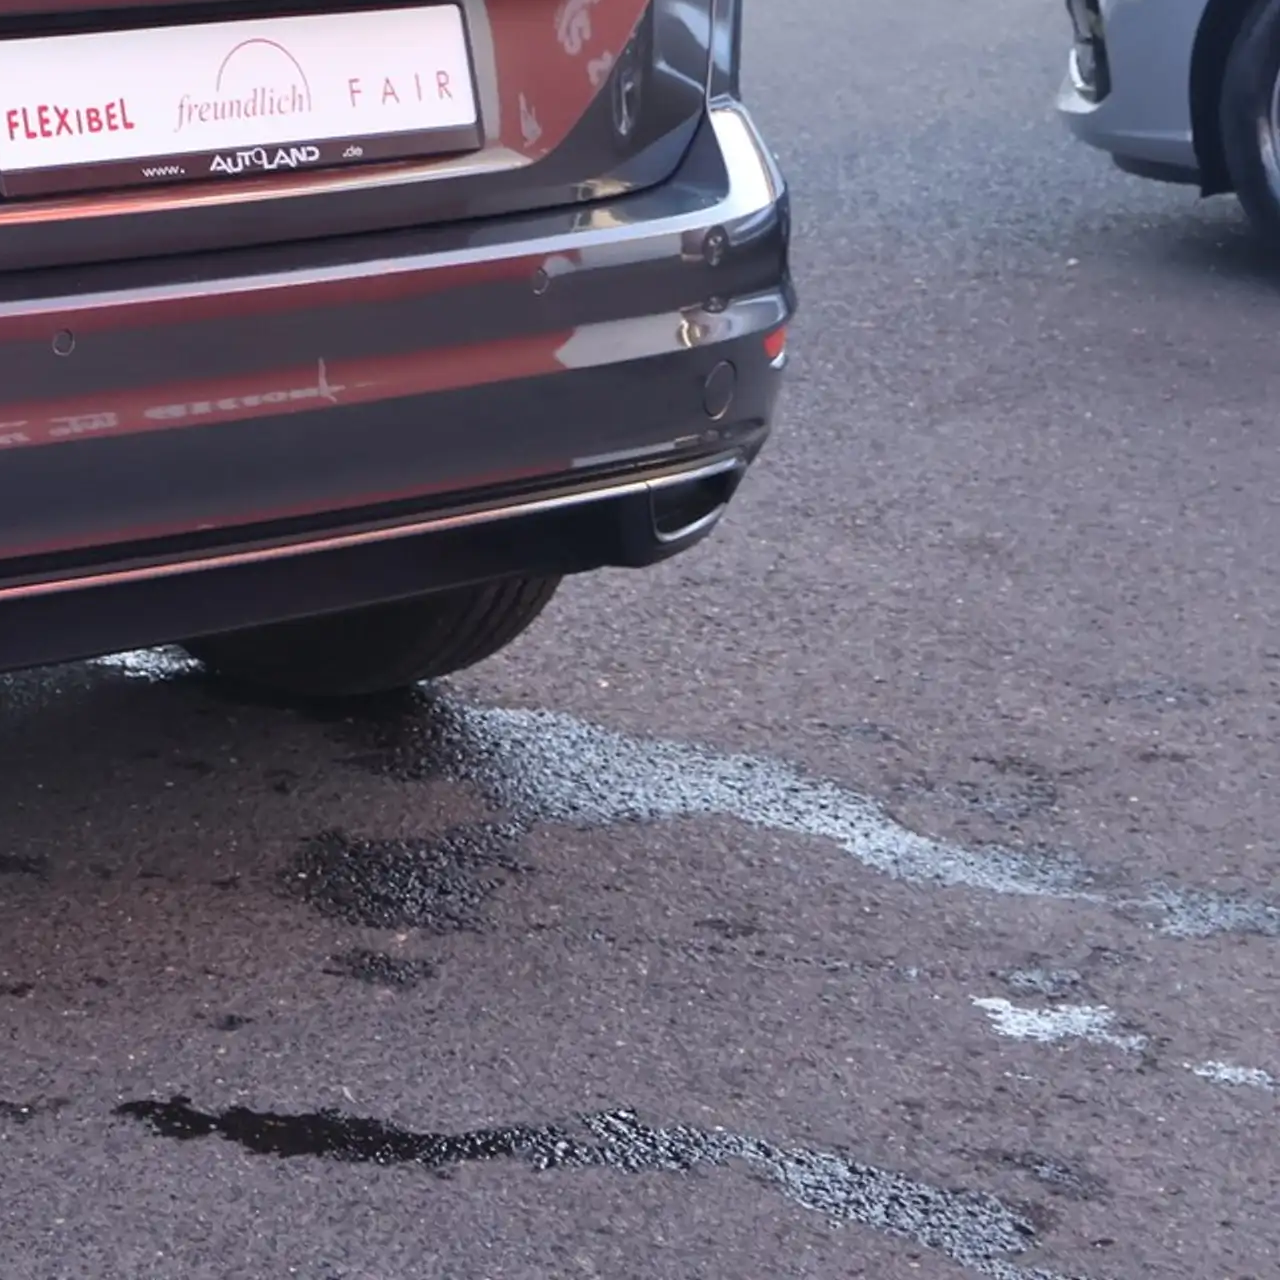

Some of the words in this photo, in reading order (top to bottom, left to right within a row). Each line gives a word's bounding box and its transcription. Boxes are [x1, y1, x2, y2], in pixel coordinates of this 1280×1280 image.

[6, 97, 135, 140] FLEXIBEL
[174, 84, 306, 132] freundlich
[348, 70, 453, 108] FAIR
[141, 164, 186, 178] www.
[209, 145, 321, 174] AUTOLAND
